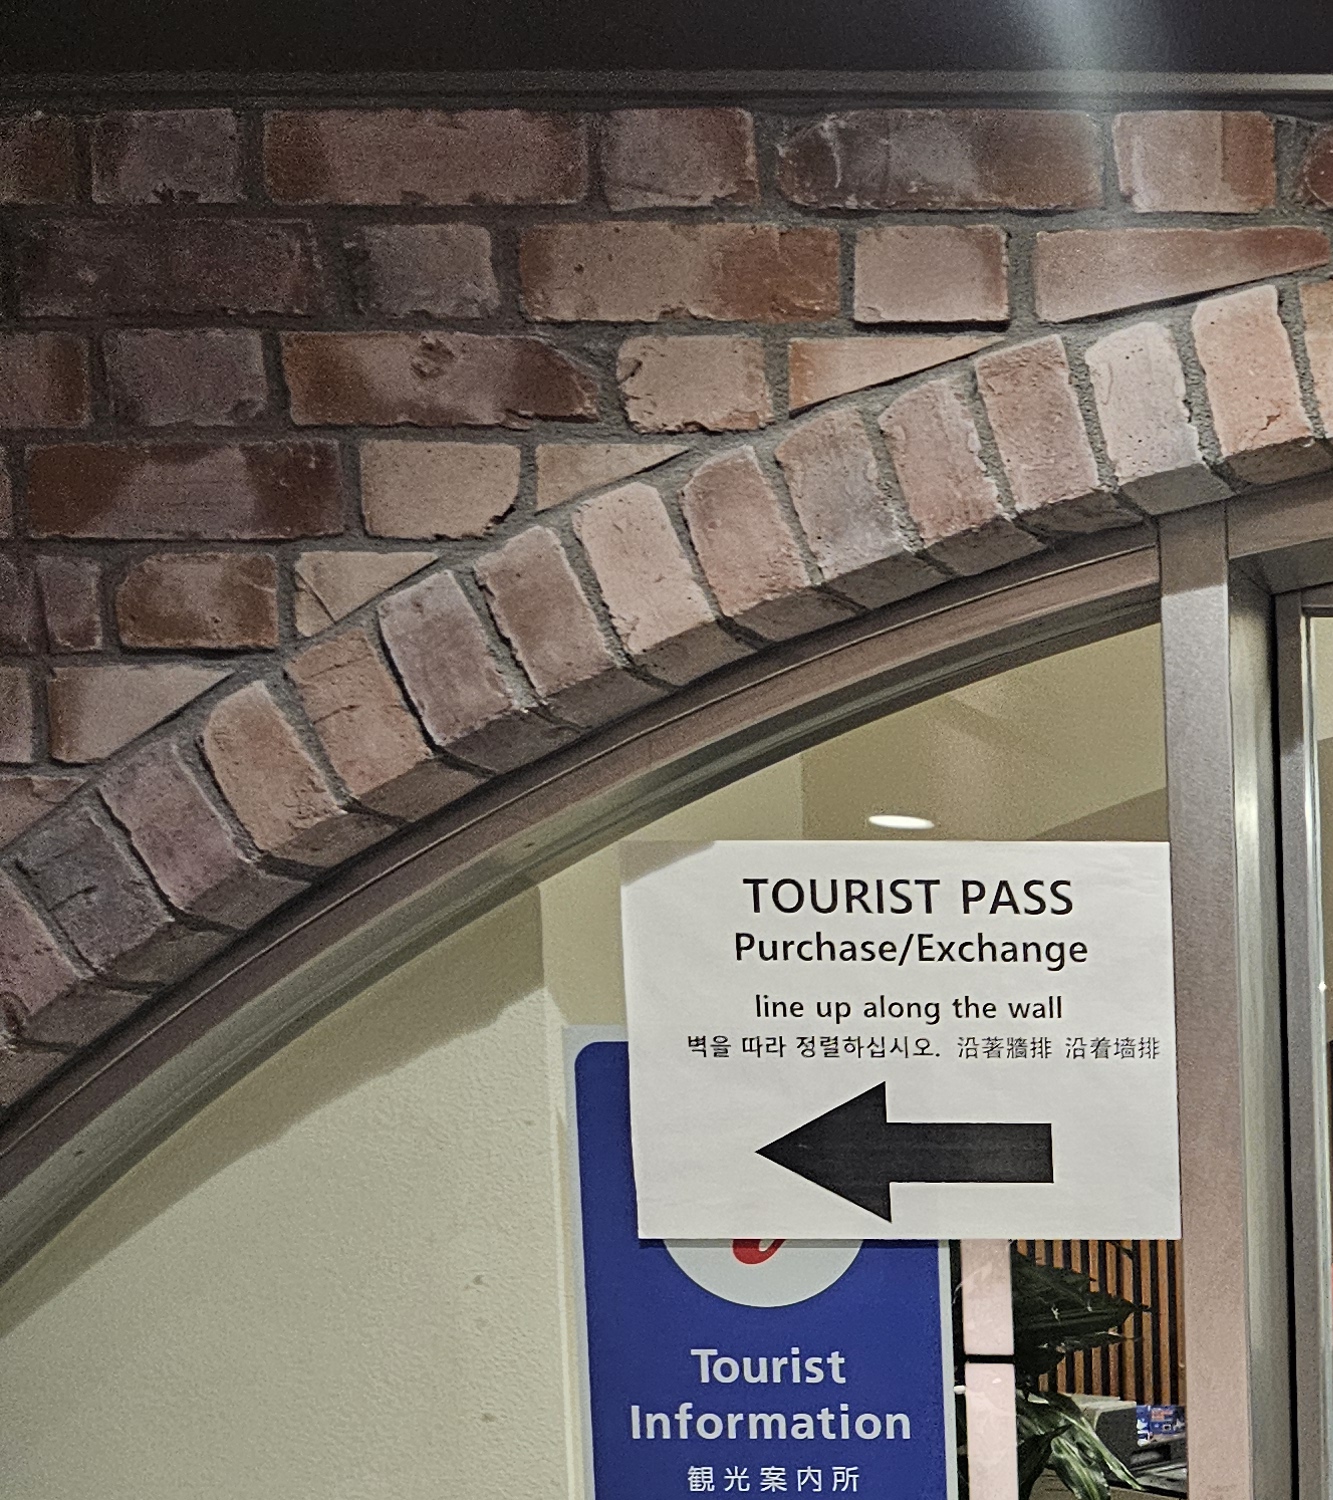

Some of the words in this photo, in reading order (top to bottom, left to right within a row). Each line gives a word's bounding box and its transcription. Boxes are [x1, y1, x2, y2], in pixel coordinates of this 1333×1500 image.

[743, 878, 940, 914] TOURIST
[962, 880, 1072, 915] PASS
[736, 932, 1087, 971] Purchase/Exchange
[756, 994, 803, 1017] line
[817, 1002, 851, 1024] up
[864, 995, 940, 1025] along
[952, 996, 996, 1018] the
[1008, 996, 1061, 1018] wall
[688, 1036, 731, 1057] 벽을
[742, 1036, 786, 1058] 따라
[796, 1036, 940, 1058] 정렬하십시오.
[691, 1347, 846, 1383] Tourist
[631, 1403, 910, 1439] Information
[688, 1466, 859, 1492] 観光案内所
